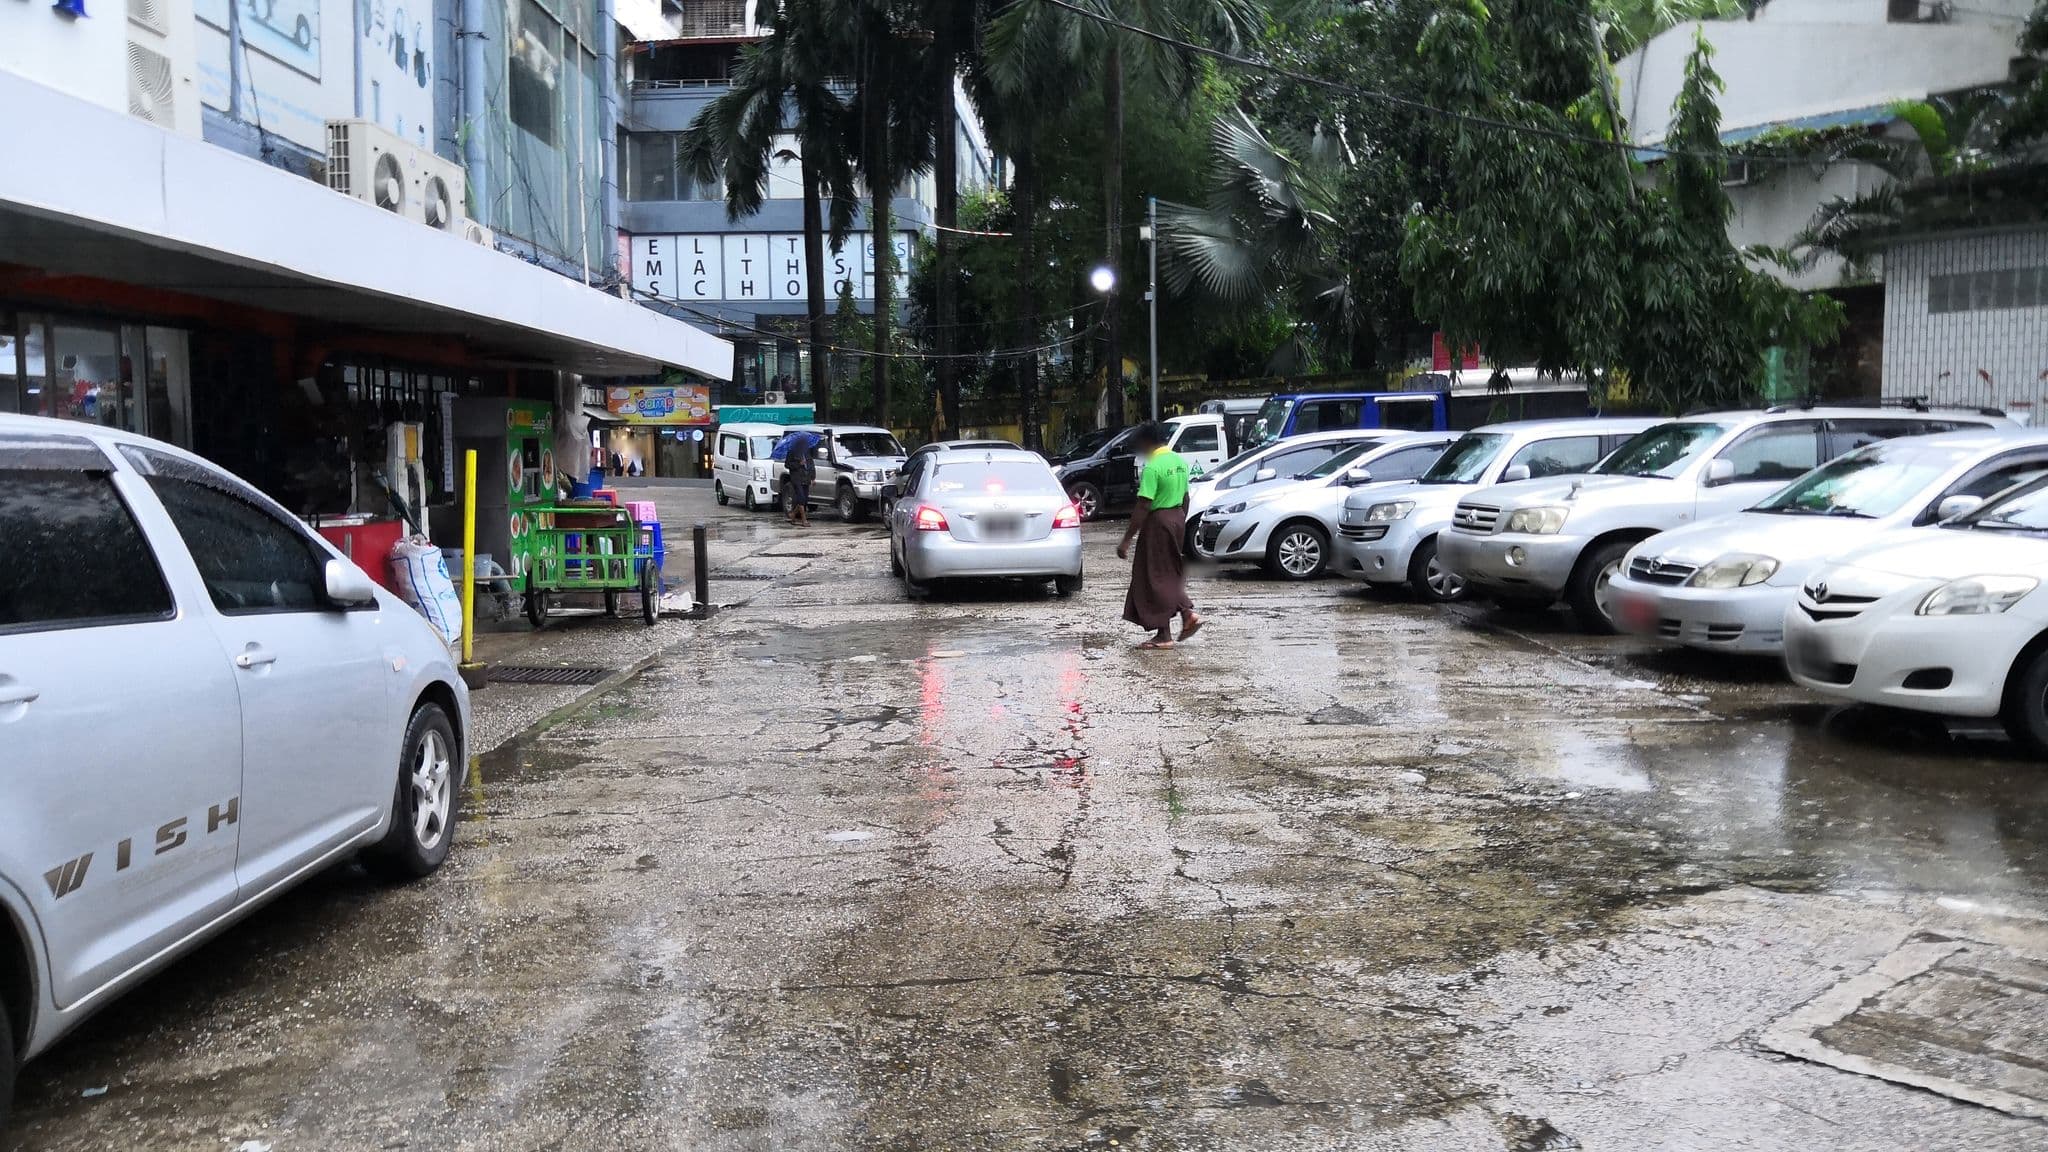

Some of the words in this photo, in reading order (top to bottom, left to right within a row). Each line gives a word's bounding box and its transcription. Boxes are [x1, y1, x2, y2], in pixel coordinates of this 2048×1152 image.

[648, 237, 845, 255] ELIT
[638, 397, 674, 411] camp
[43, 796, 239, 900] WISH
